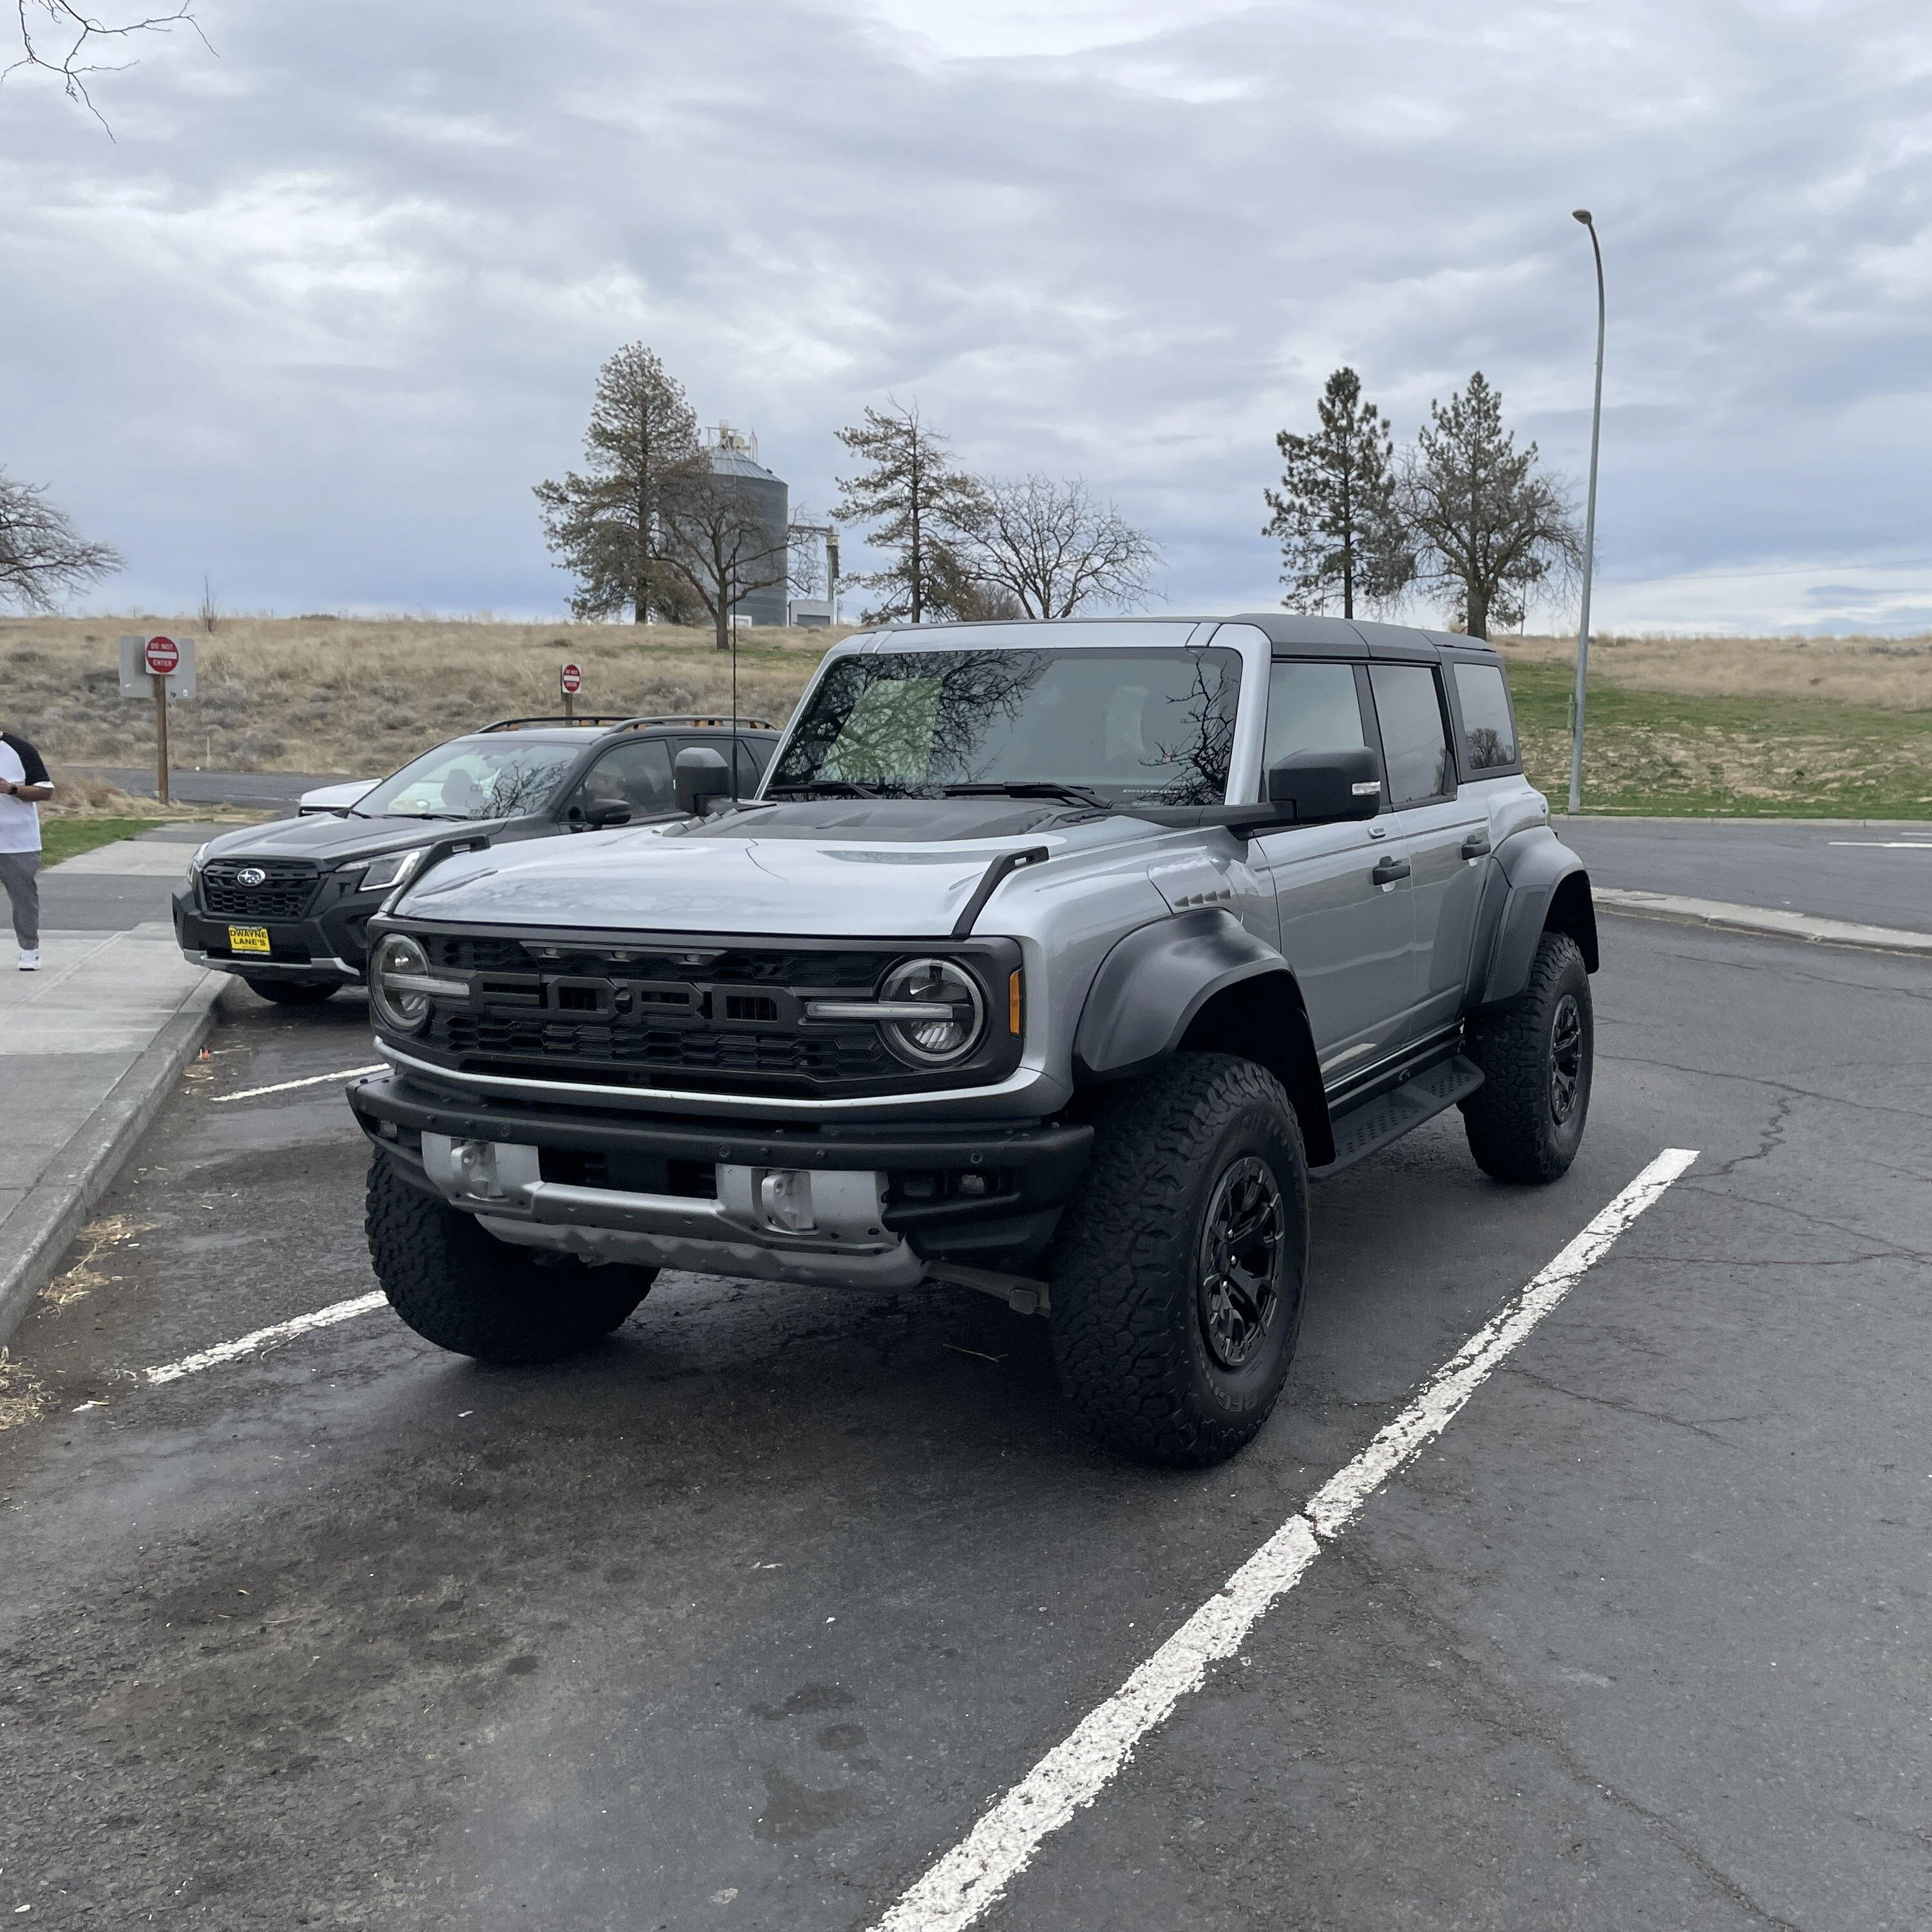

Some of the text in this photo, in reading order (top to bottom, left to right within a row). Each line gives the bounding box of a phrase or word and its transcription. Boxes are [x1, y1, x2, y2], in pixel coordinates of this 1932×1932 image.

[229, 929, 267, 938] DWAYNE
[234, 938, 265, 946] LANE'S
[469, 970, 799, 1032] FORD
